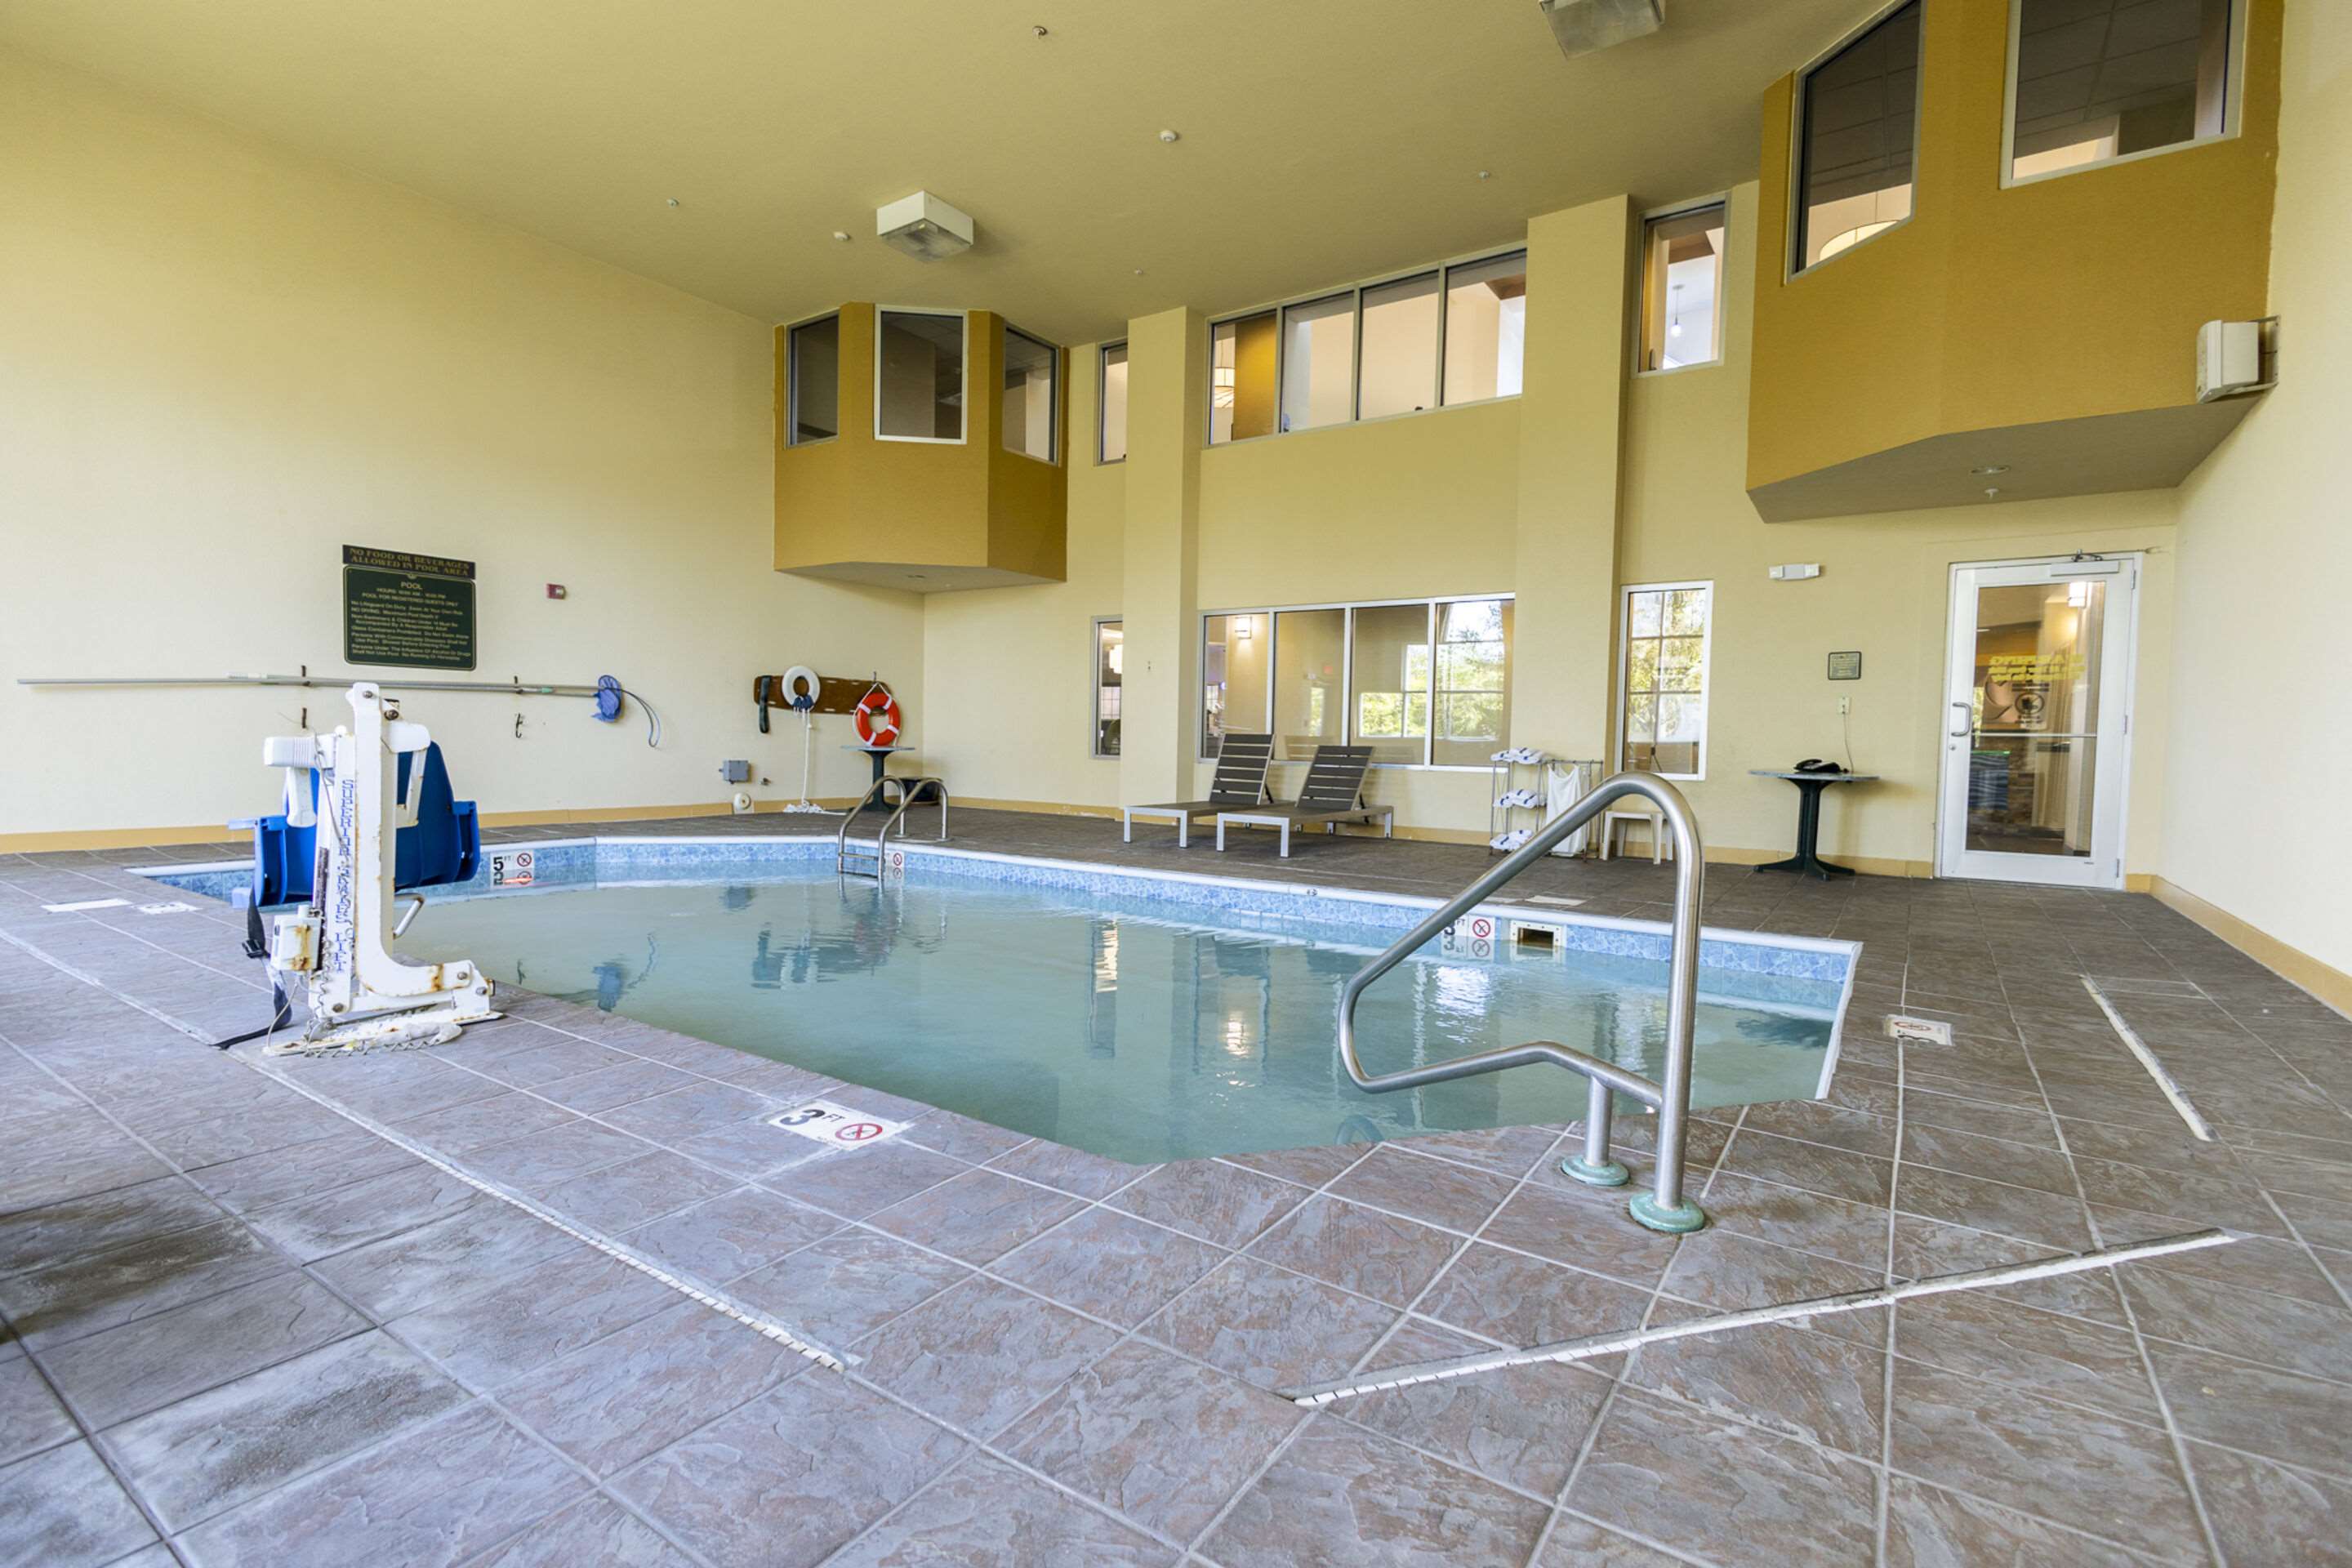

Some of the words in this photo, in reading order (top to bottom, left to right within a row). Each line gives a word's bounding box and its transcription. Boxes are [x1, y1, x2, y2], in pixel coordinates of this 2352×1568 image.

[350, 548, 363, 556] NO
[367, 550, 394, 559] FOOD
[414, 557, 470, 569] BEVERAGES
[353, 556, 400, 568] ALLOWED
[416, 564, 439, 572] POOL
[401, 581, 422, 590] POOL
[493, 857, 504, 871] 5
[1456, 918, 1466, 927] FT
[333, 933, 347, 972] LIFT
[780, 1109, 826, 1126] 3
[822, 1113, 846, 1124] FT
